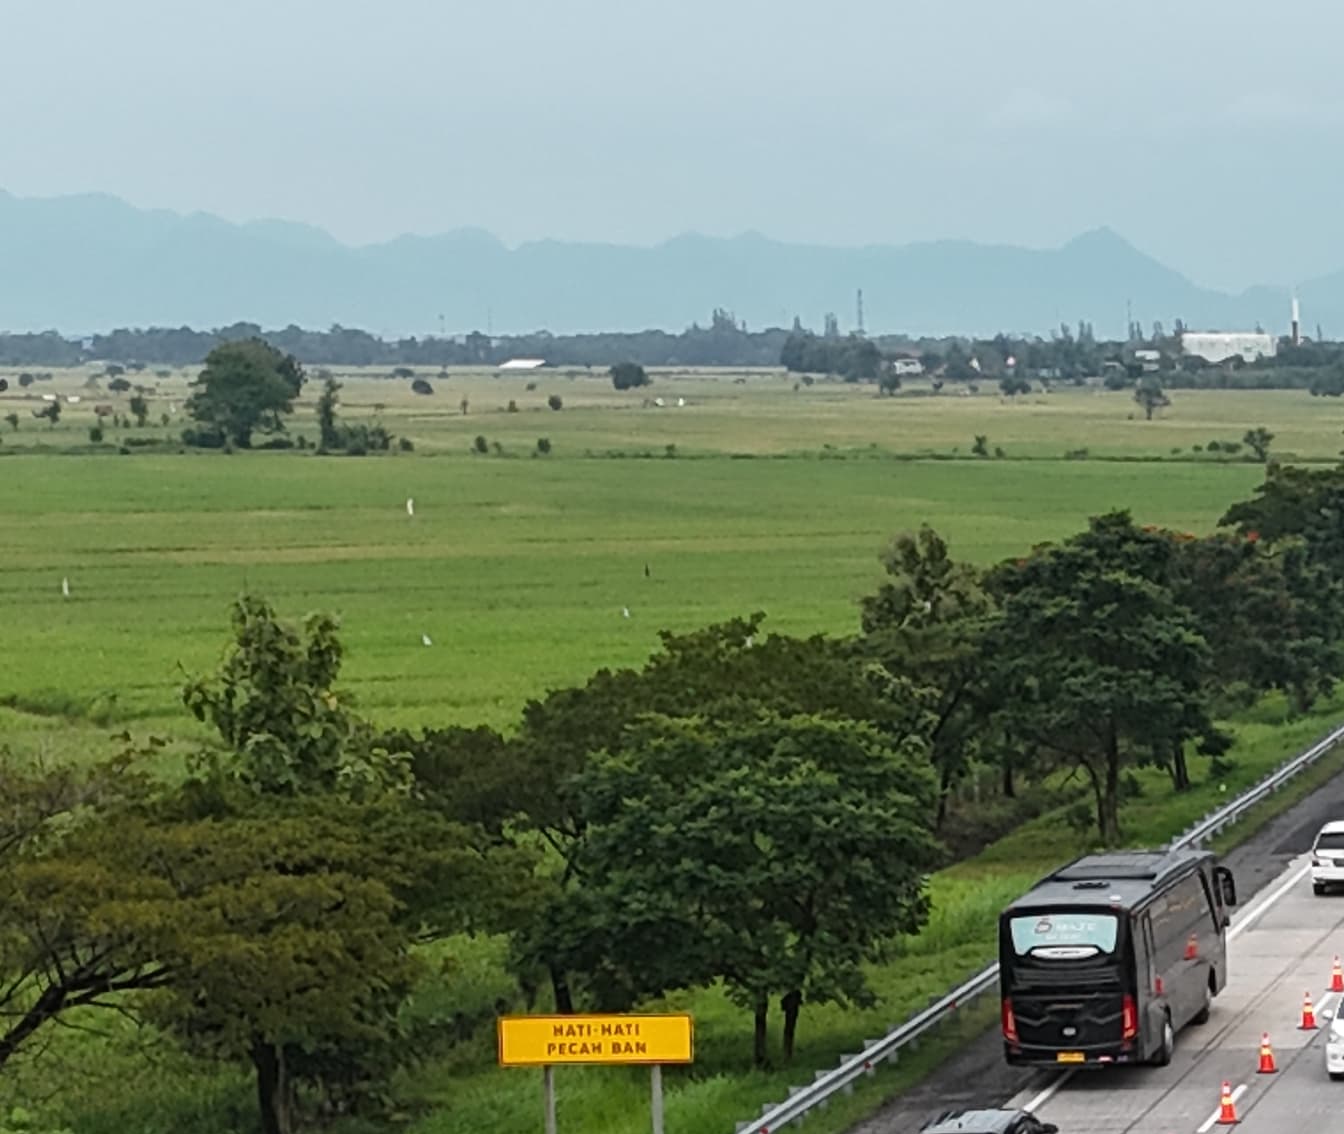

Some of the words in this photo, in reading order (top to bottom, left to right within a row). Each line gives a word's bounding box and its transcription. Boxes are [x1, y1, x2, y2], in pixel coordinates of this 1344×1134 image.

[553, 1024, 640, 1037] HATI-HATI
[547, 1041, 602, 1055] PECAH
[611, 1041, 647, 1055] BAN
